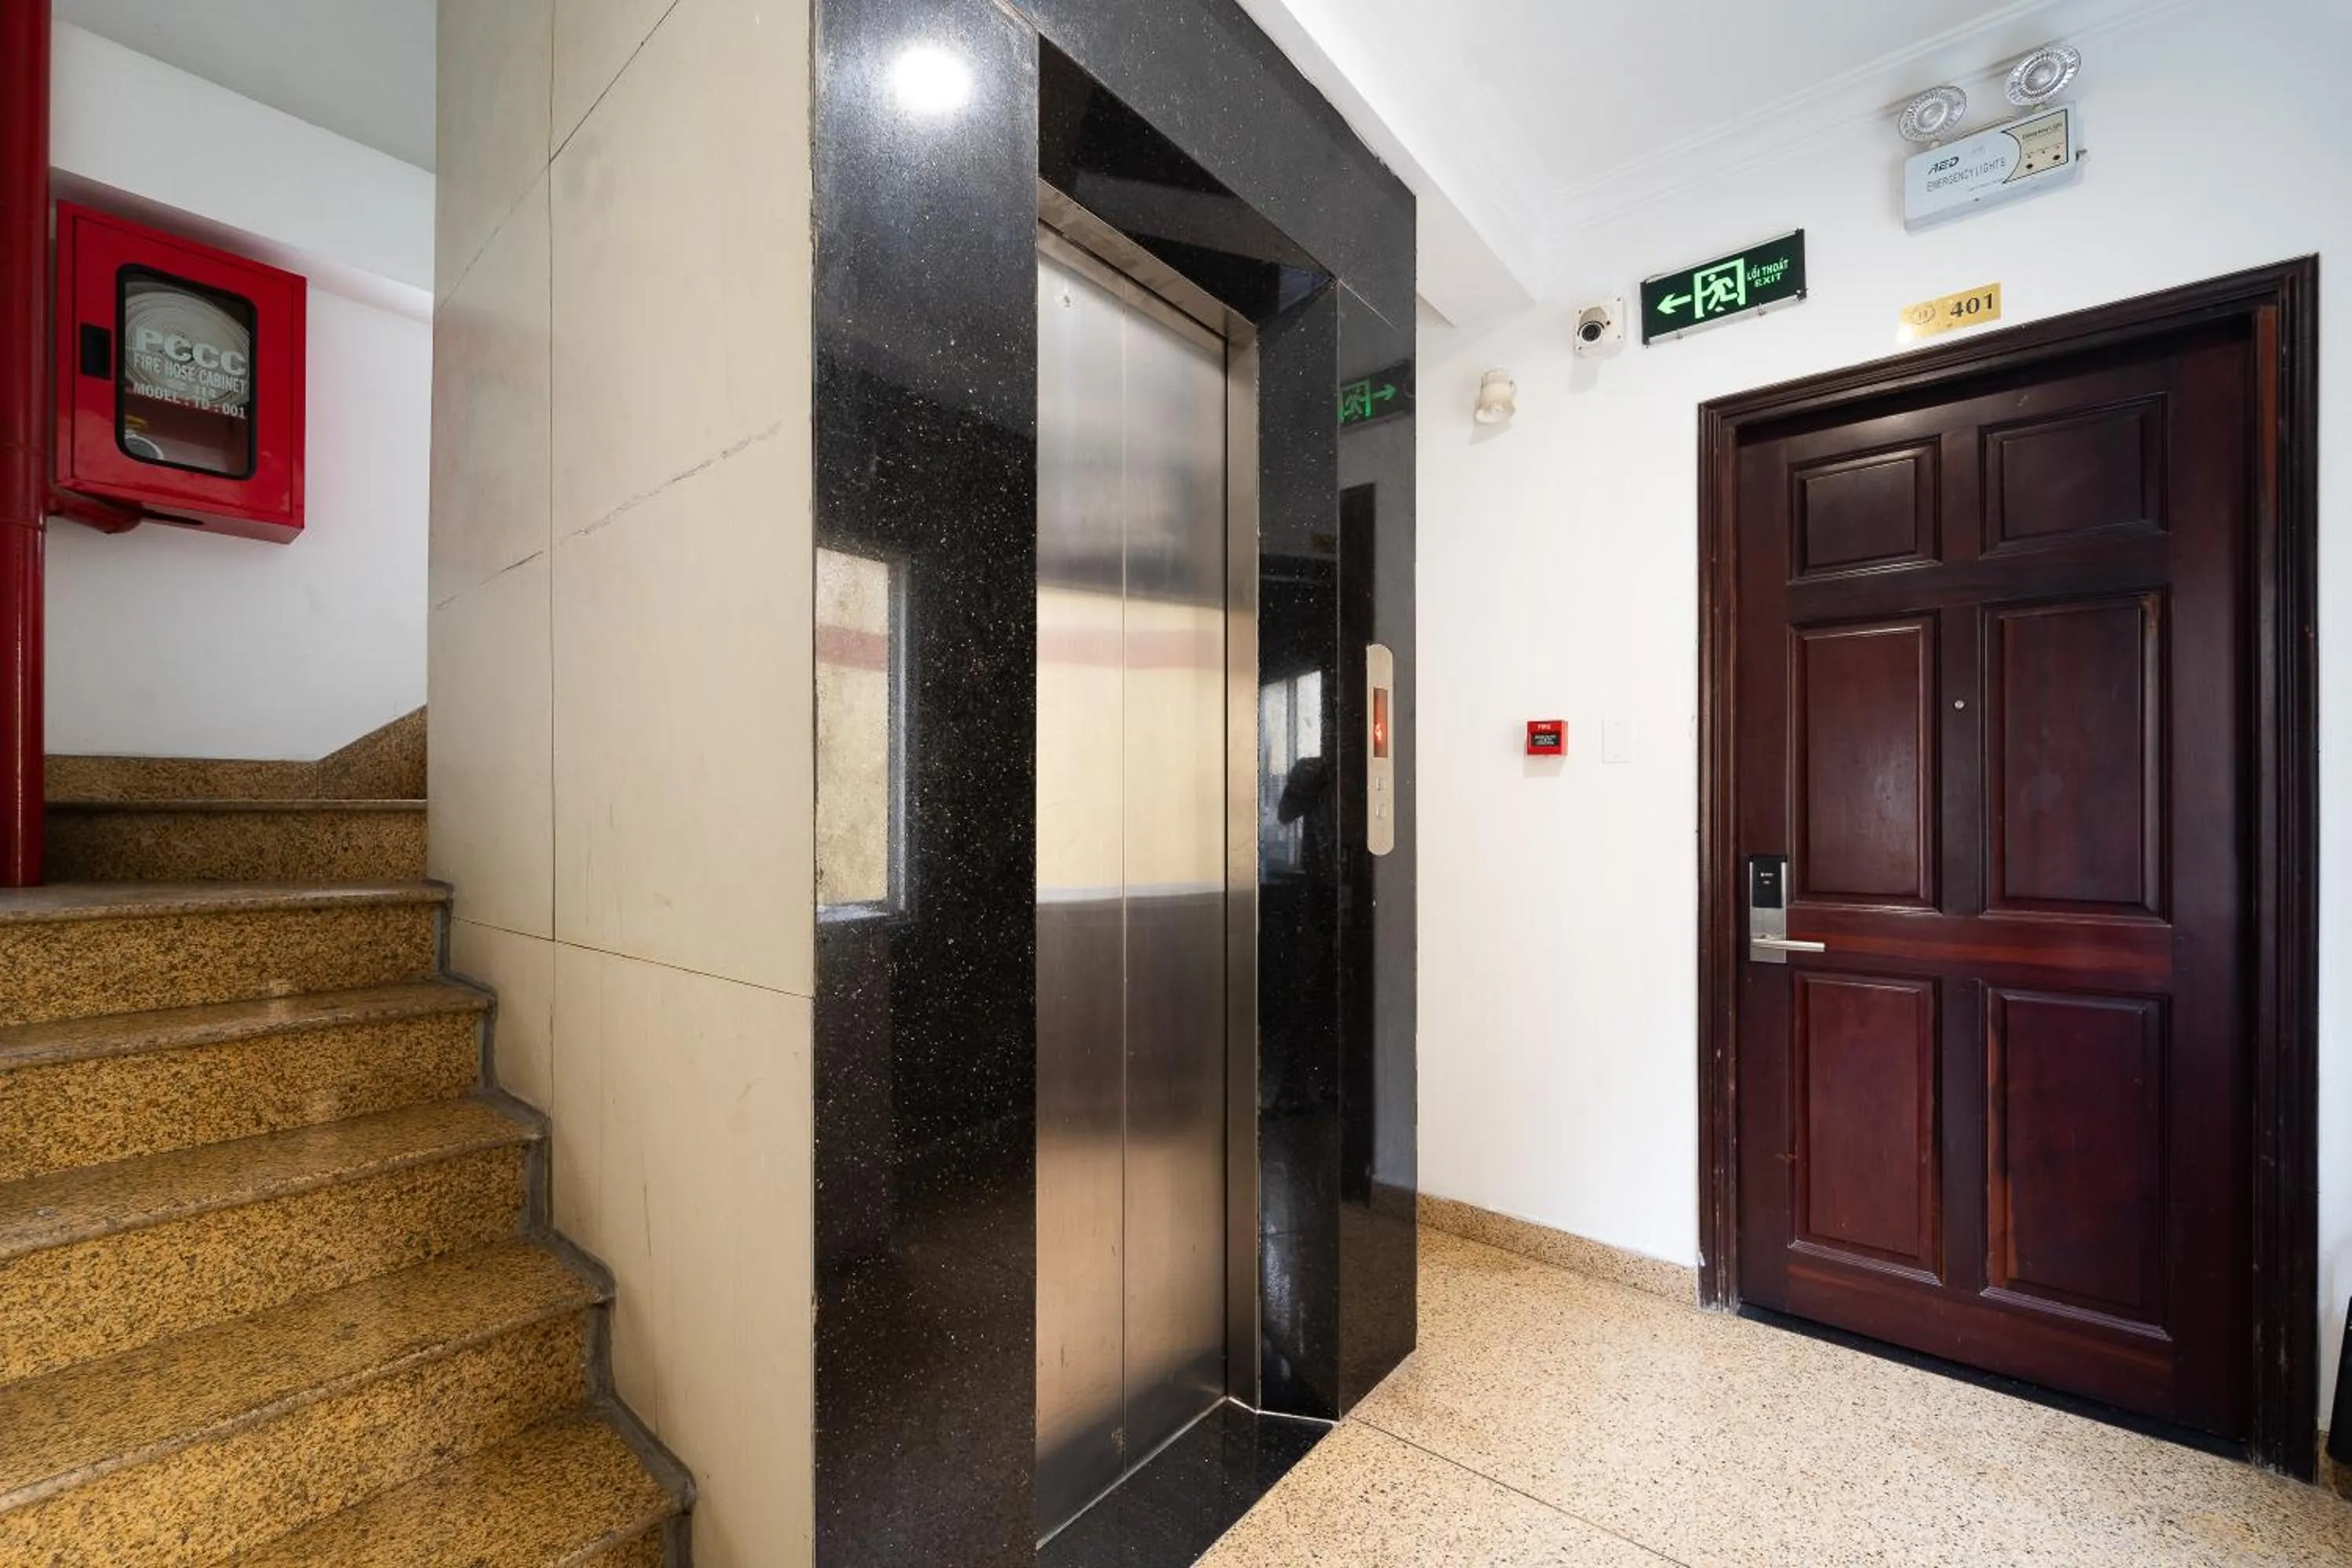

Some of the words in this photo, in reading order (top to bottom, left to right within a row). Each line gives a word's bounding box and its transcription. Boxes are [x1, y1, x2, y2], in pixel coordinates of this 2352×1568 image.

[1926, 168, 1973, 192] EMERGENCY
[1975, 156, 2006, 177] LIGHTS
[1755, 272, 1782, 288] EXIT
[1762, 256, 1788, 276] THOÁT
[1950, 292, 1993, 318] 401
[135, 326, 247, 376] PCCC
[133, 352, 162, 374] FIRE
[164, 360, 196, 382] HOSE
[199, 369, 246, 394] CABINET
